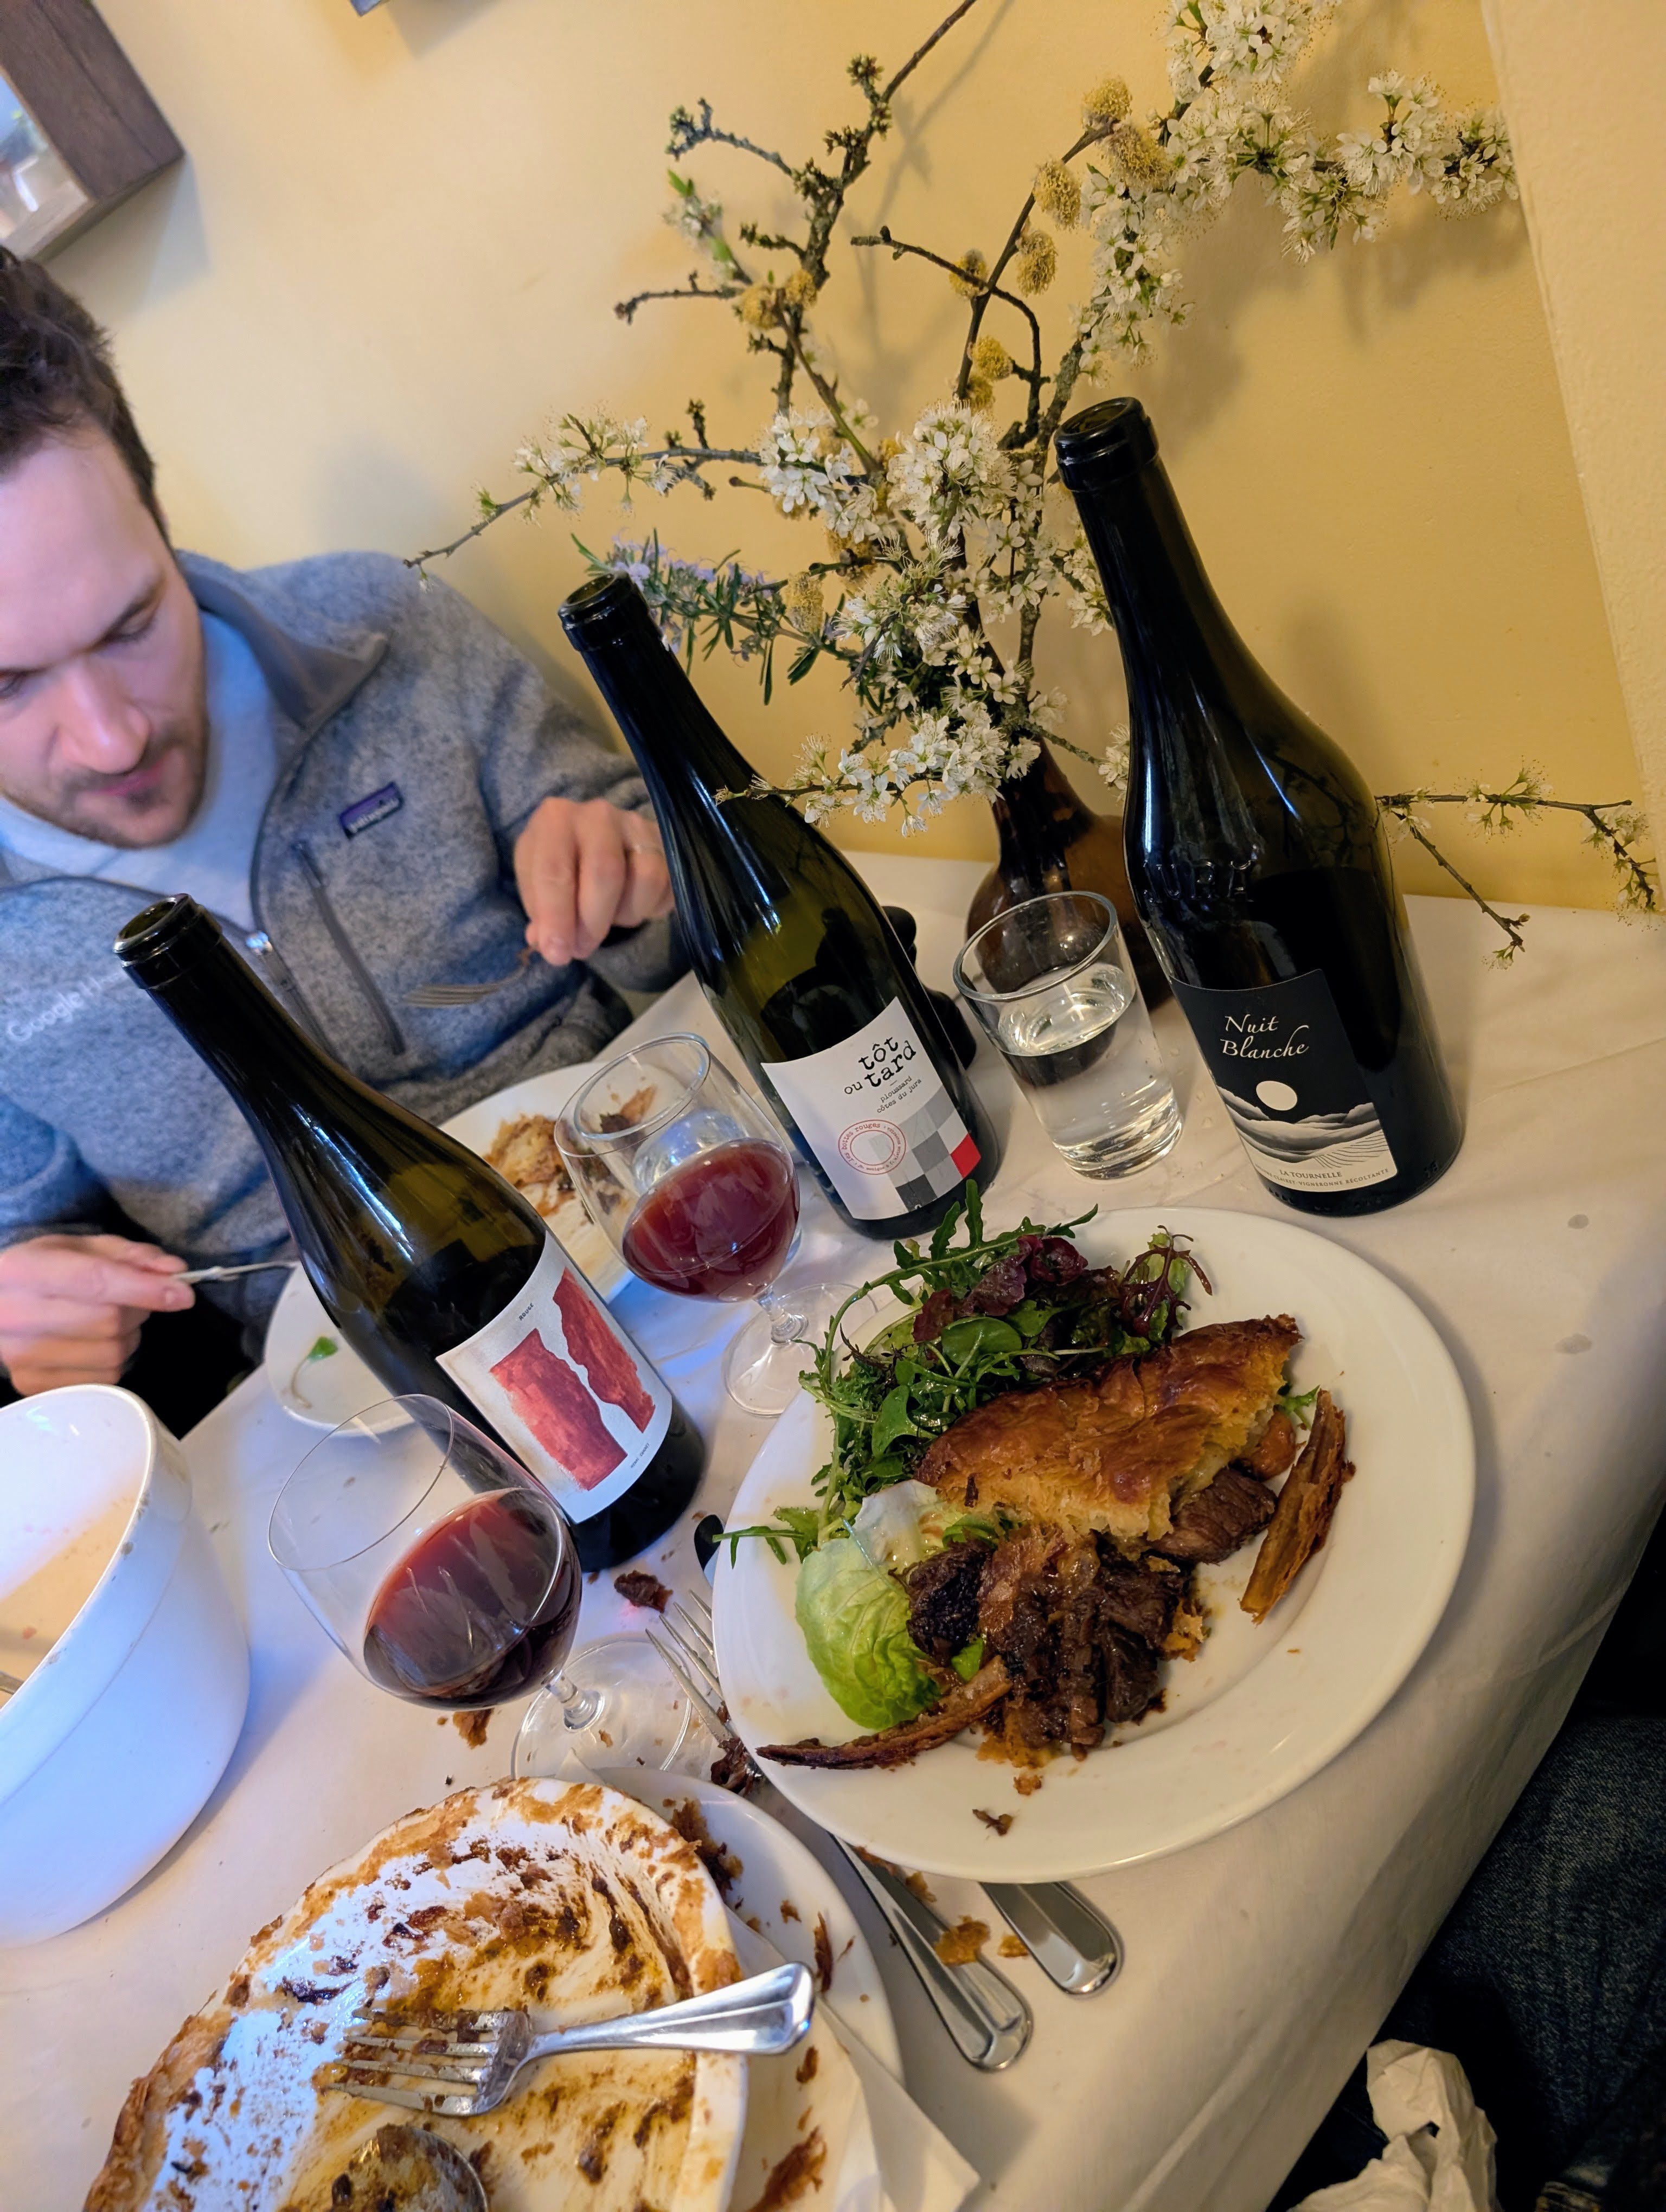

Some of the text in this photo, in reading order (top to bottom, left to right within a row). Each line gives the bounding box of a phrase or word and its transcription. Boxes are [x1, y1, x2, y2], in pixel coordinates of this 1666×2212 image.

[1225, 1014, 1279, 1033] Nuit
[858, 1037, 899, 1070] tôt
[1220, 1025, 1310, 1059] Blanche
[844, 1040, 917, 1095] ou tard
[877, 1078, 922, 1114] côtes du jura
[880, 1076, 912, 1103] ploussard
[854, 1123, 881, 1133] rouges
[1290, 1171, 1343, 1179] TOURNELLE
[518, 1302, 534, 1321] ROUGE
